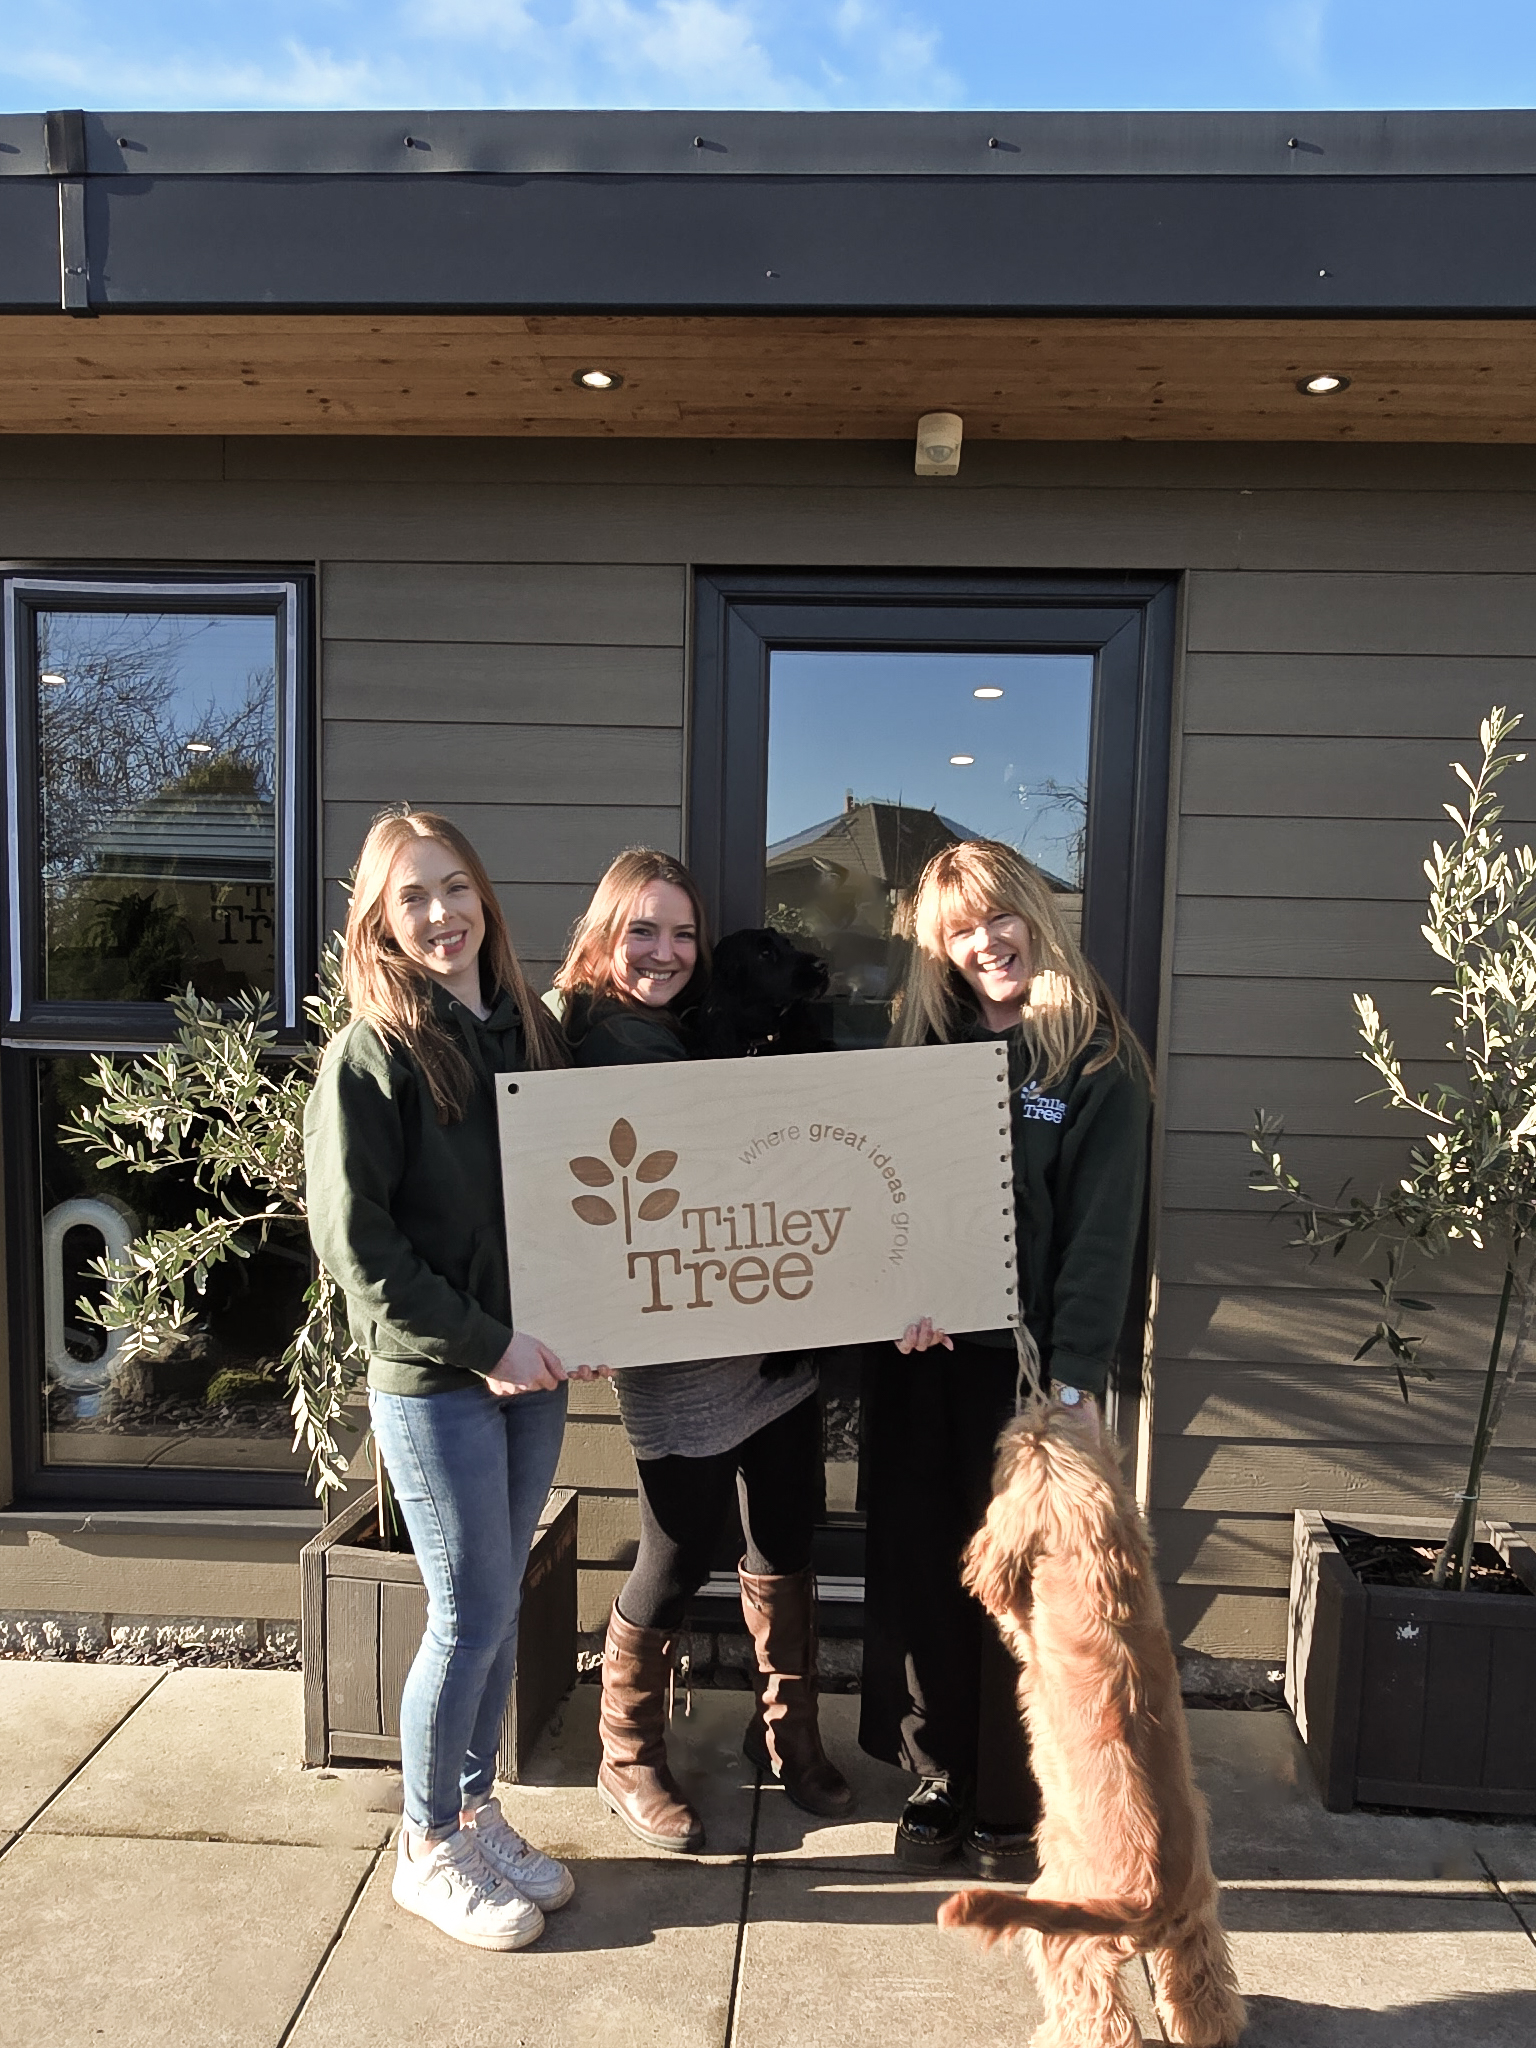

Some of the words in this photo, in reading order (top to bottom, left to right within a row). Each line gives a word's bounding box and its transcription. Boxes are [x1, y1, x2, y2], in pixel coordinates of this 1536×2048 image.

[211, 905, 274, 945] Tr
[1022, 1104, 1063, 1124] Tree
[1037, 1097, 1067, 1115] Tille
[738, 1125, 800, 1165] where
[809, 1123, 867, 1152] great
[867, 1144, 907, 1205] ideas
[682, 1201, 852, 1255] Tilley
[627, 1248, 815, 1314] Tree
